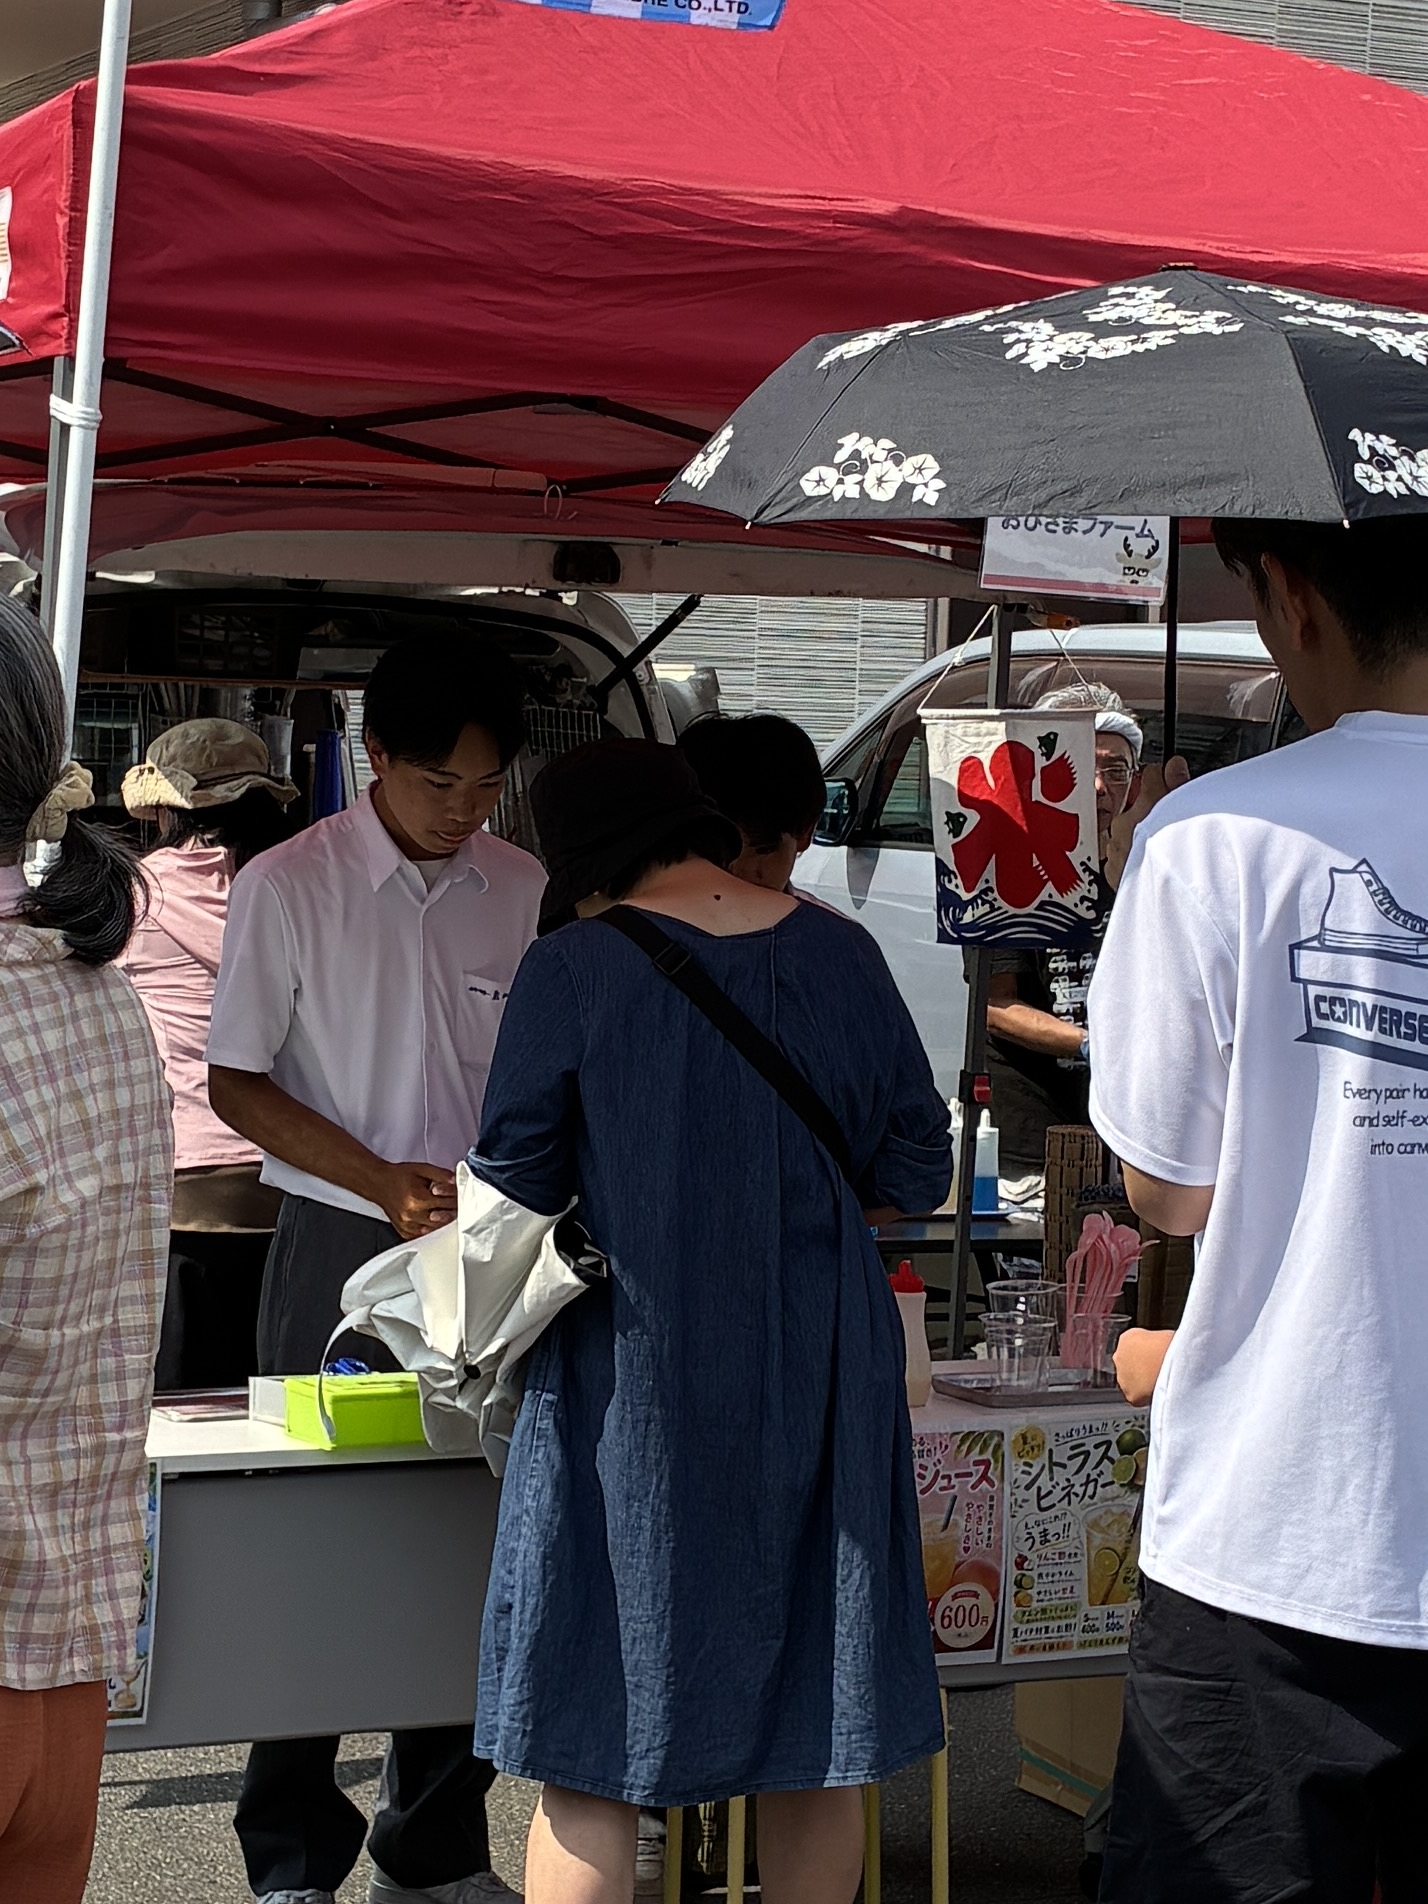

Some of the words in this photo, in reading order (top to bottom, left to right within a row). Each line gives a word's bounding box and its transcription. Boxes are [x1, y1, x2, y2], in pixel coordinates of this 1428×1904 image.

[951, 739, 1080, 909] 氷
[1343, 1080, 1383, 1105] Every
[1384, 1084, 1412, 1104] pair
[1353, 1112, 1380, 1128] and
[1370, 1139, 1394, 1155] into
[1021, 1440, 1116, 1491] シトラス
[1037, 1470, 1115, 1512] ビネガー
[940, 1603, 989, 1630] 600円
